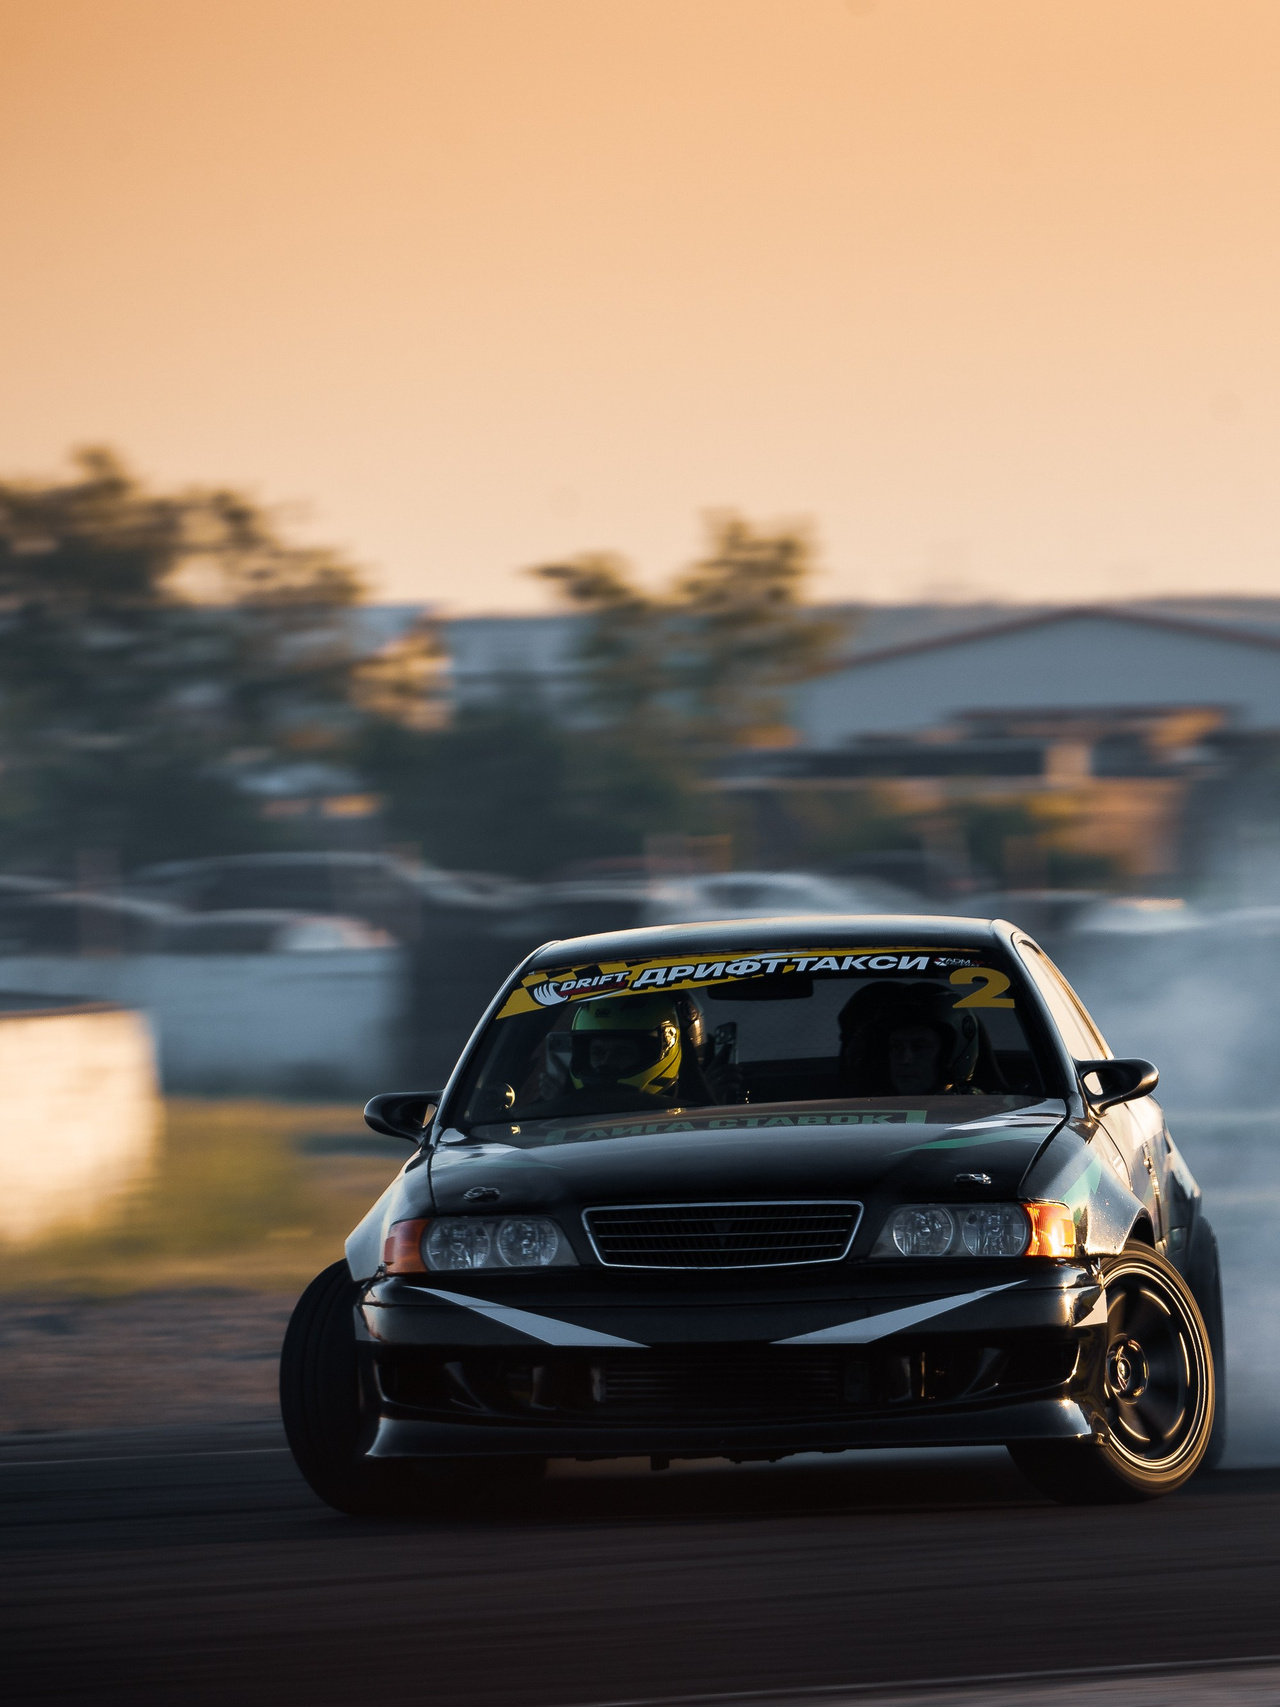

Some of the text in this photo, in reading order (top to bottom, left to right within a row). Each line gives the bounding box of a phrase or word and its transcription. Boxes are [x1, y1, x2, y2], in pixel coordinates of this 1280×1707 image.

[559, 971, 630, 992] DRIFT
[633, 958, 788, 988] ДРИФТ
[791, 956, 930, 973] ТАКСИ
[948, 966, 1016, 1009] 2
[576, 1114, 893, 1140] ЛИГА СТАВОК
